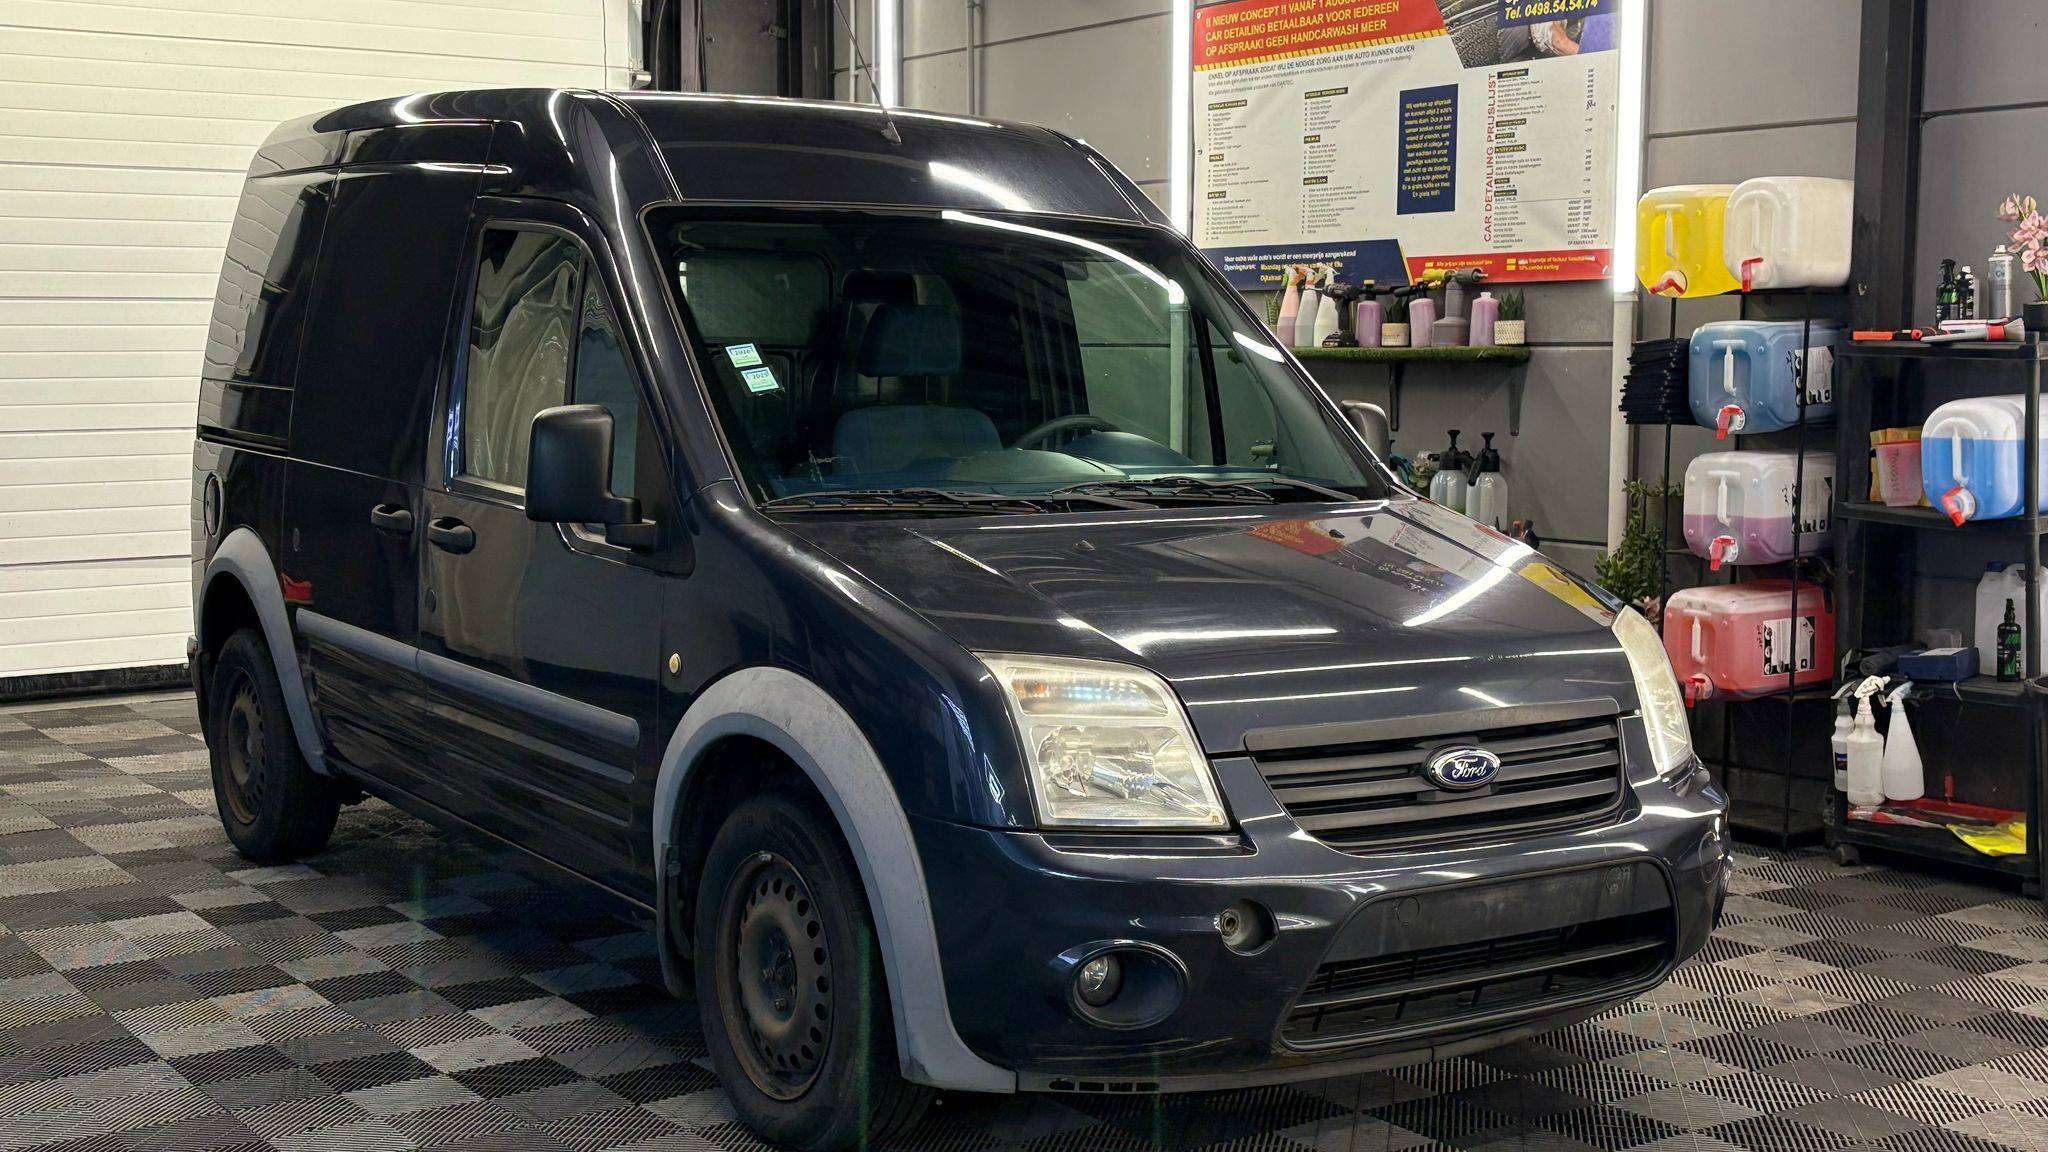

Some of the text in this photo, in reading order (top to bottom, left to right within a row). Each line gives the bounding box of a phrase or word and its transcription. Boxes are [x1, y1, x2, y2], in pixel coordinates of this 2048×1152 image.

[1205, 30, 1222, 42] CAR
[1223, 24, 1266, 39] DETAILING
[1267, 13, 1324, 32] BETAALBAAR
[1326, 9, 1352, 23] VOOR
[1353, 1, 1400, 19] IEDEREEN
[1212, 12, 1240, 27] NIEUW
[1240, 5, 1280, 22] CONCEPT
[1289, 0, 1317, 13] VANAF
[1505, 6, 1522, 20] Tel.
[1205, 45, 1217, 57] OP
[1265, 35, 1289, 47] GEEN
[1290, 23, 1359, 44] HANDCARWASH
[1360, 19, 1387, 33] MEER
[1233, 67, 1259, 77] AFSPRAAK
[1354, 50, 1370, 60] AUTO
[1484, 73, 1496, 242] CAR DETAILING PRIJSLIJST
[1451, 757, 1488, 779] Ford
